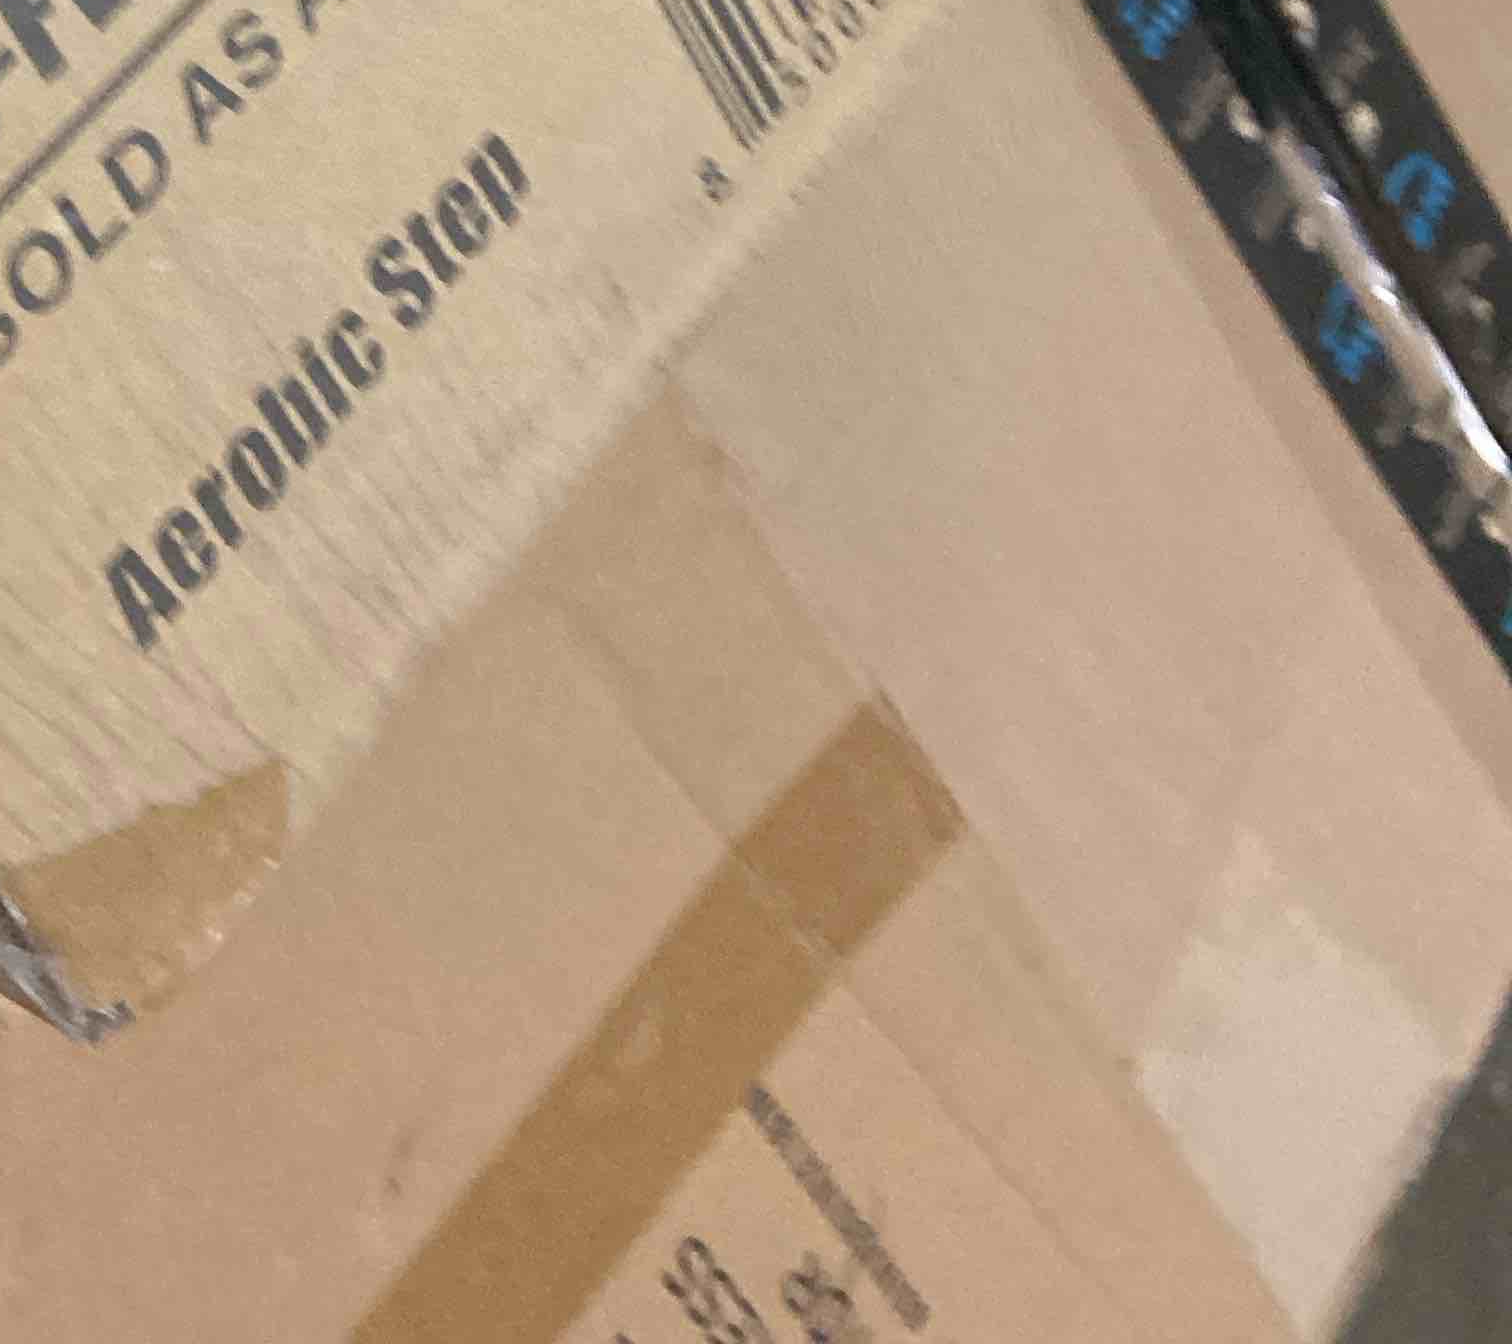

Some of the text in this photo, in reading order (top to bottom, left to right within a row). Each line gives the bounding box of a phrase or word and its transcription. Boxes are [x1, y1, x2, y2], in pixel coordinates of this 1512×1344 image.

[184, 10, 284, 144] AS
[104, 130, 532, 651] Aerobic Step
